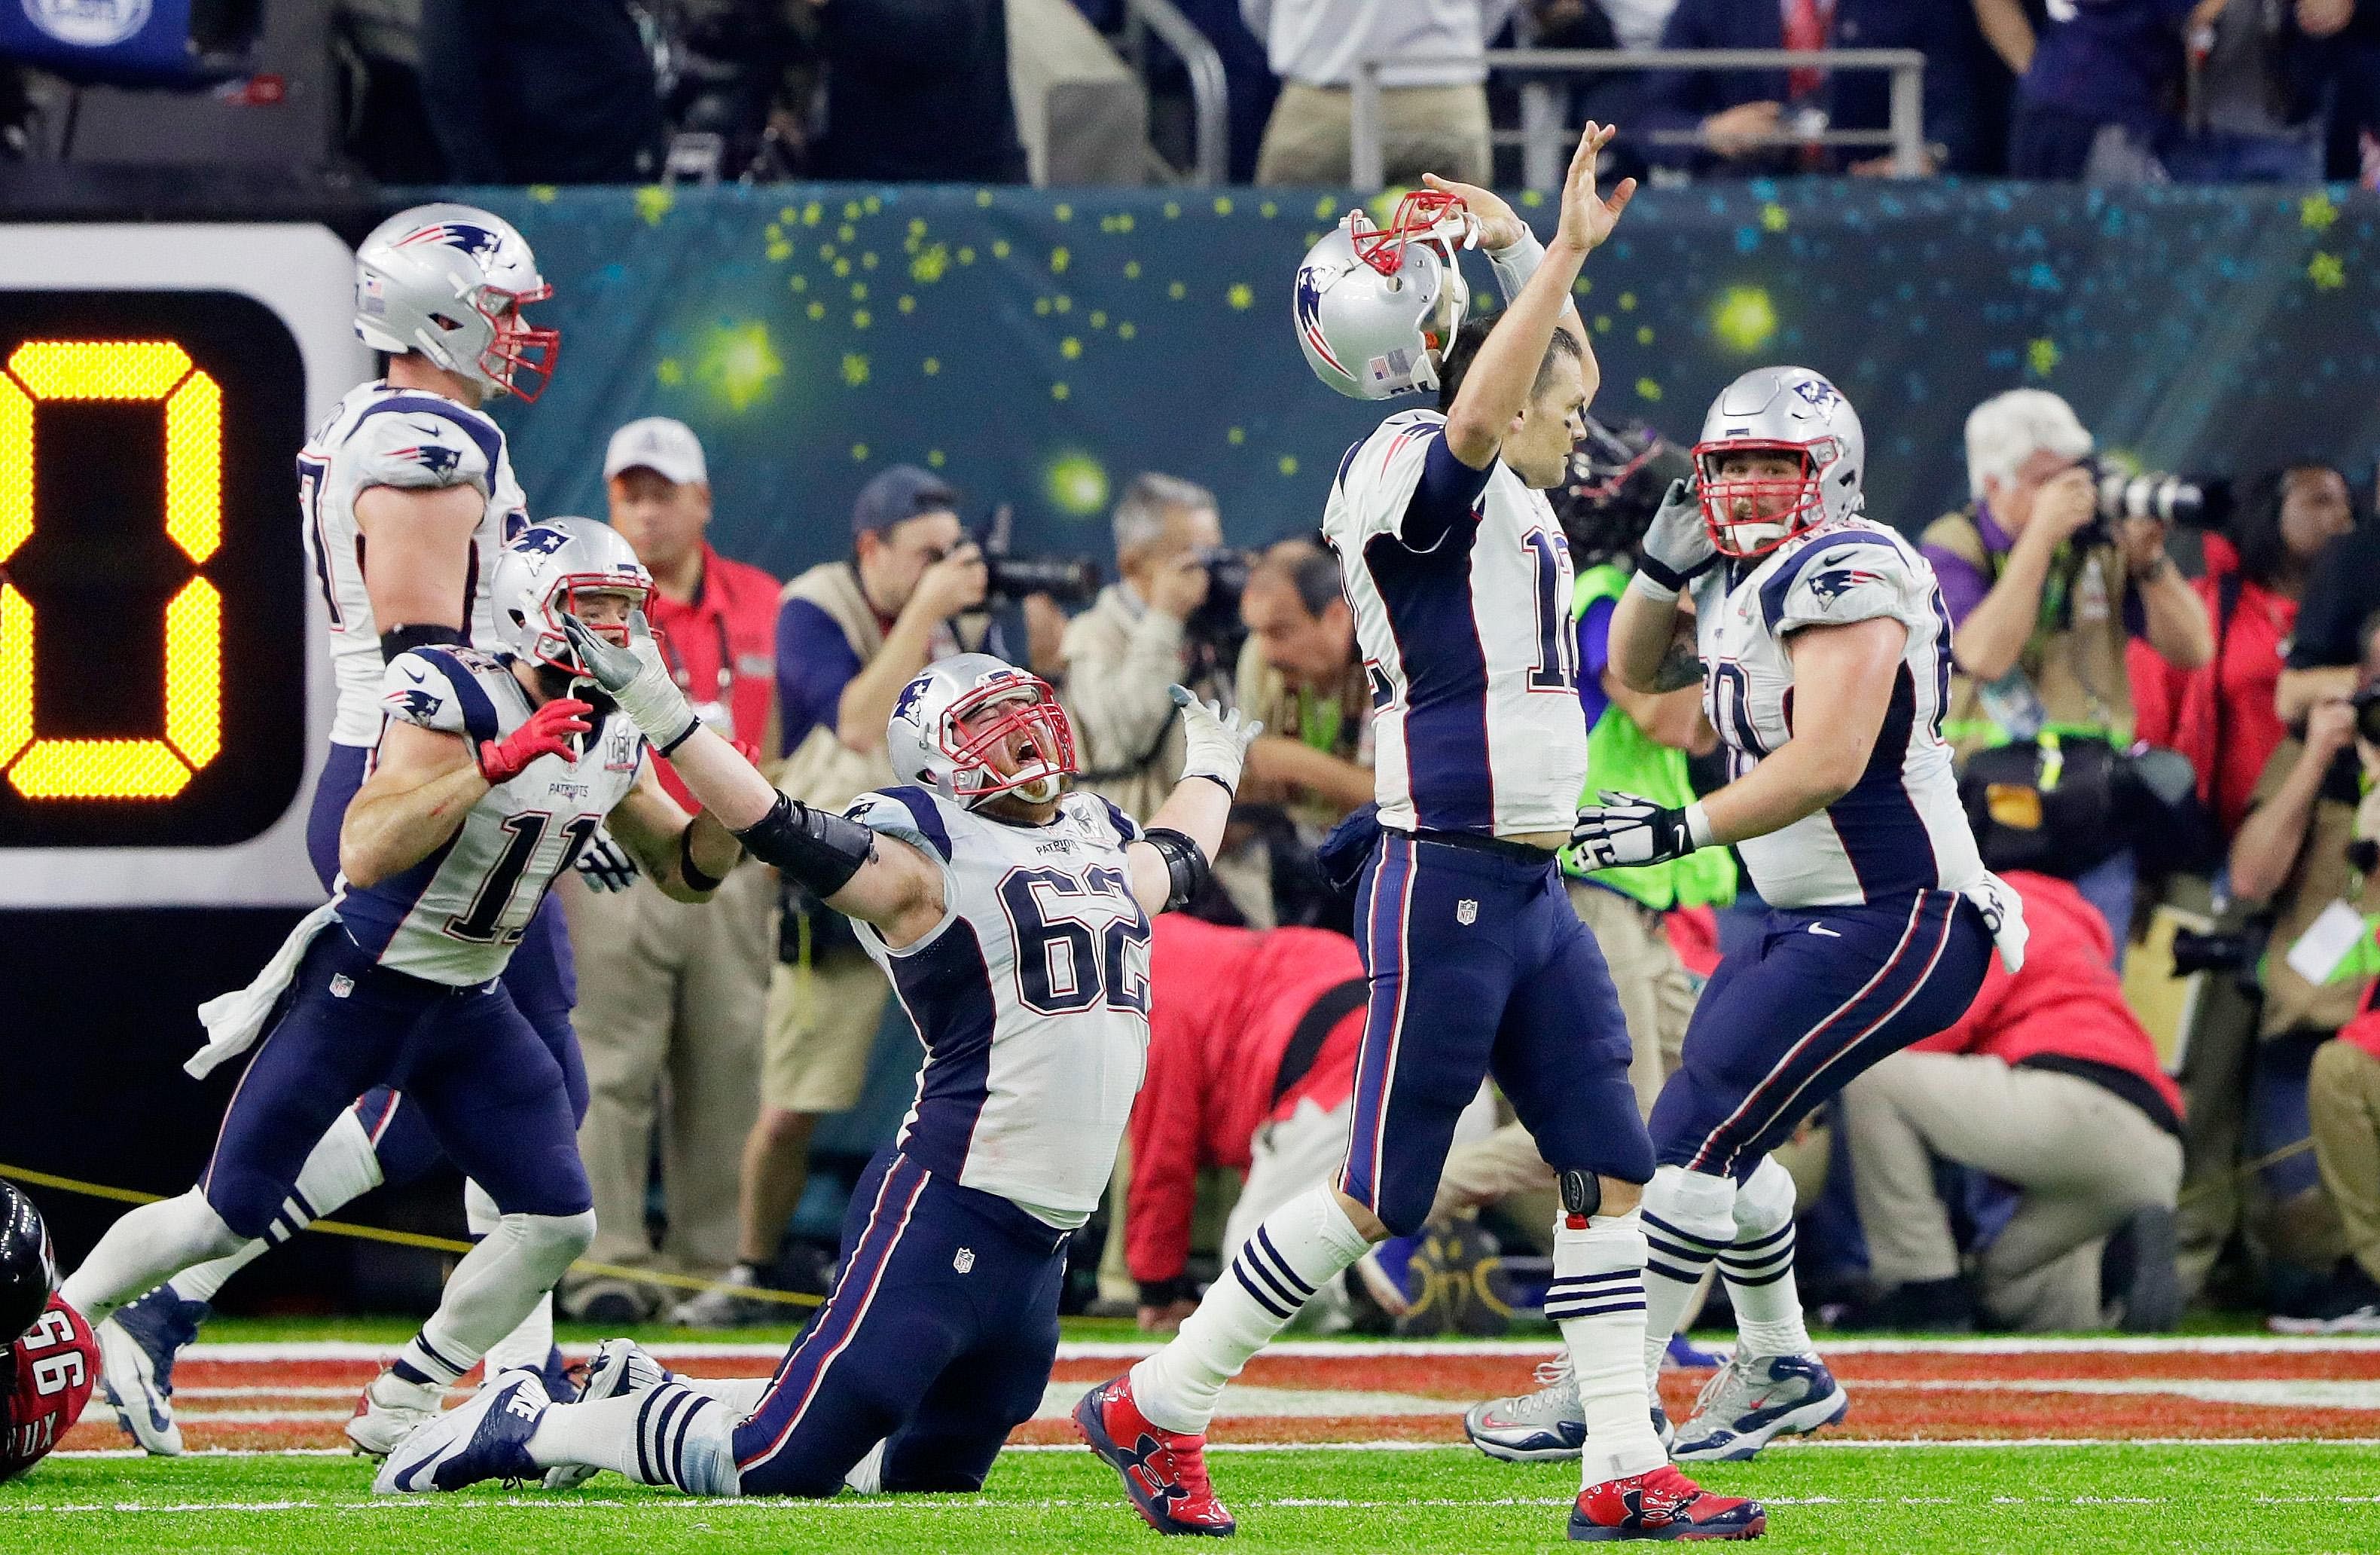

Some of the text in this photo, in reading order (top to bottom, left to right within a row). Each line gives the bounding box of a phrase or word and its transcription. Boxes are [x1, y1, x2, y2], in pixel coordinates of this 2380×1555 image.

[442, 810, 601, 943] 11
[995, 863, 1152, 1022] 62
[22, 1309, 85, 1395] 95
